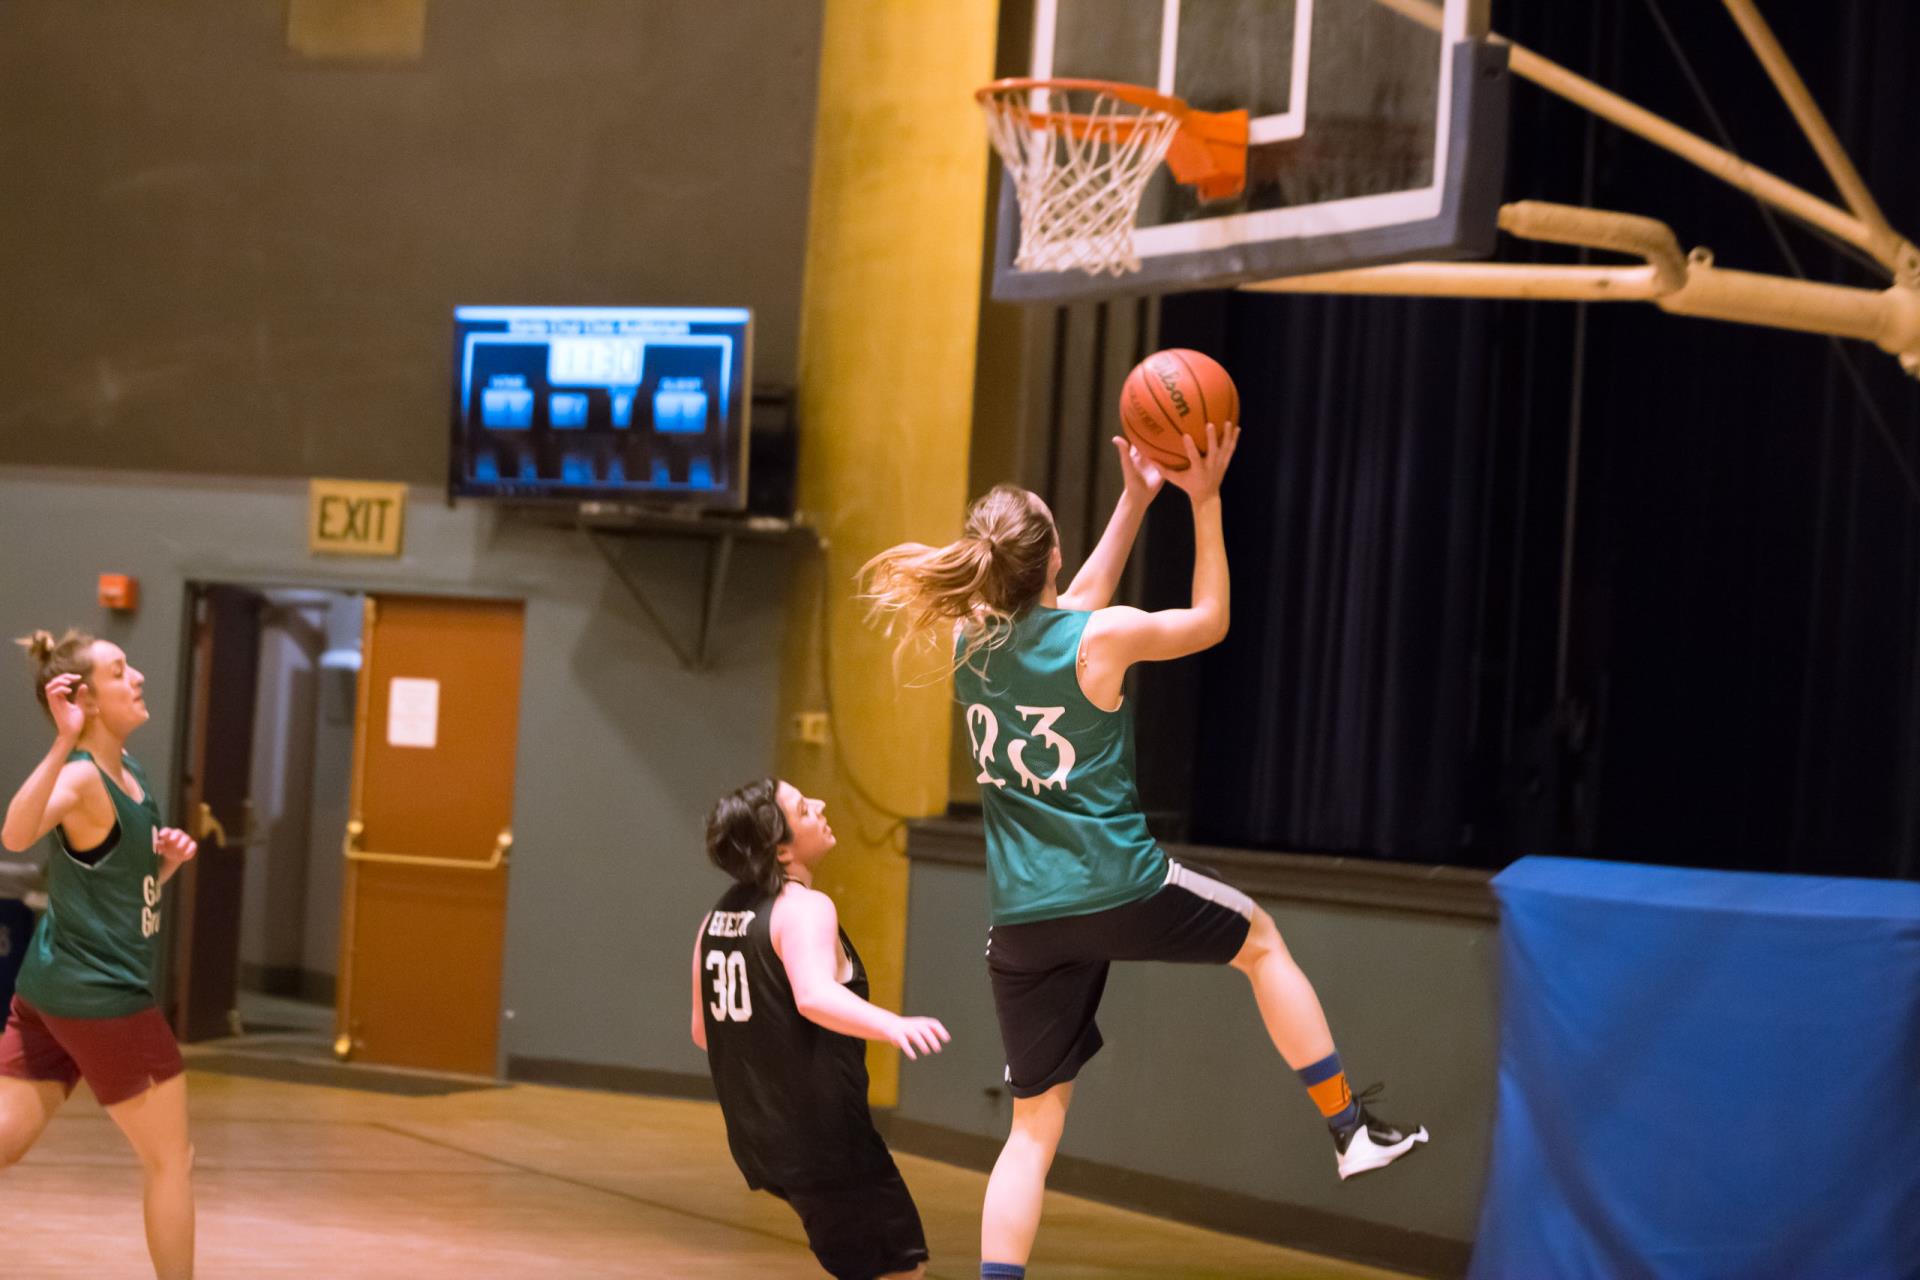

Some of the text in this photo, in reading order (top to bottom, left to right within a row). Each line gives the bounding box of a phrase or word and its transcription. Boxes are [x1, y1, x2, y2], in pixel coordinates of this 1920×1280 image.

[1153, 357, 1190, 417] ilson
[319, 495, 394, 543] EXIT
[967, 703, 1076, 795] 23
[706, 949, 753, 1022] 30
